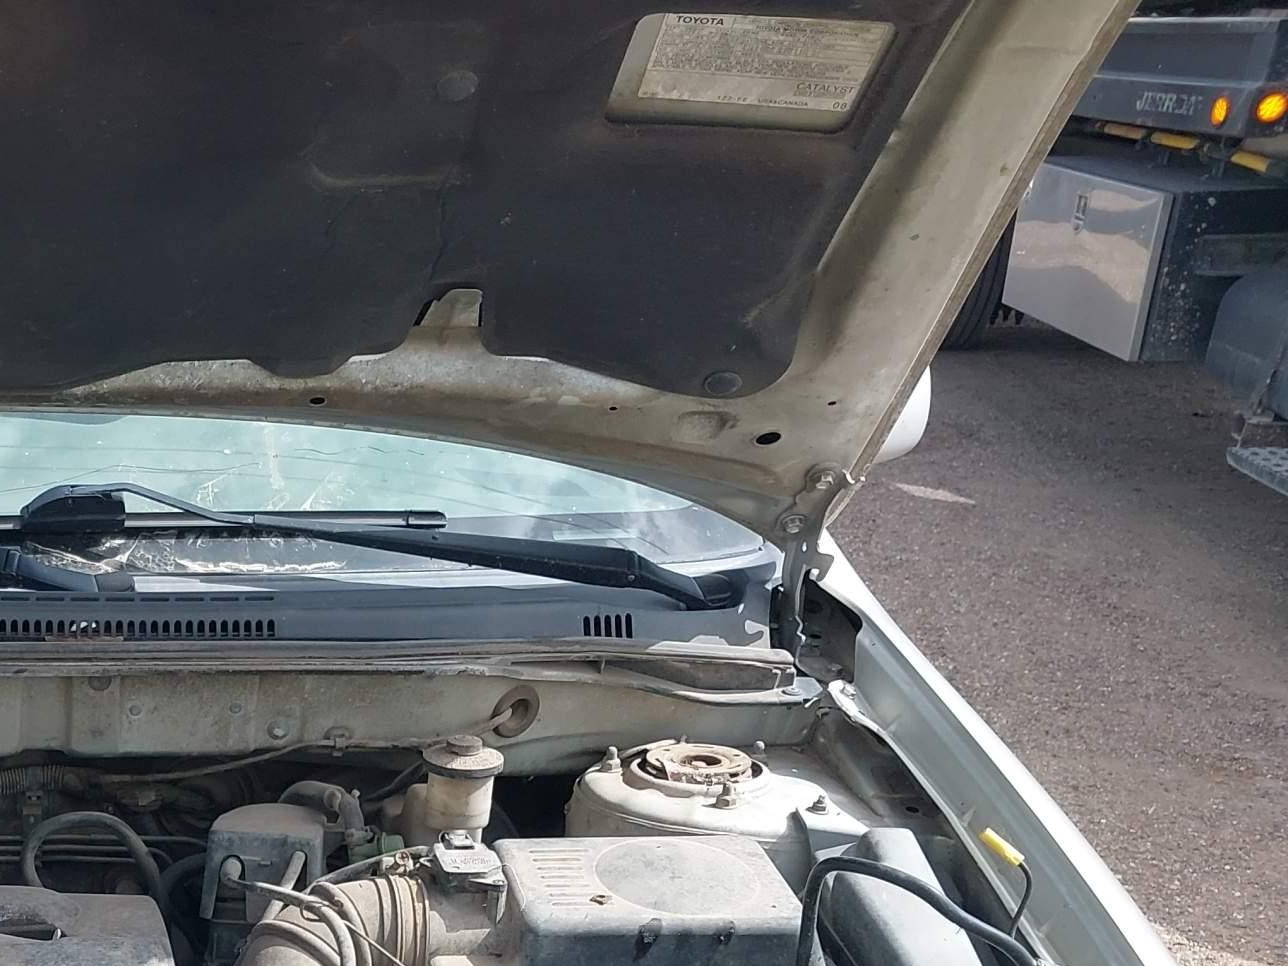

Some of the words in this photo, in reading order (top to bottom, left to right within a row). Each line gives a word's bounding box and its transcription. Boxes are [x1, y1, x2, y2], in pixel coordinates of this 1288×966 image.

[675, 15, 724, 26] TOYOTA
[796, 82, 855, 94] CATALYST
[832, 101, 848, 110] 08
